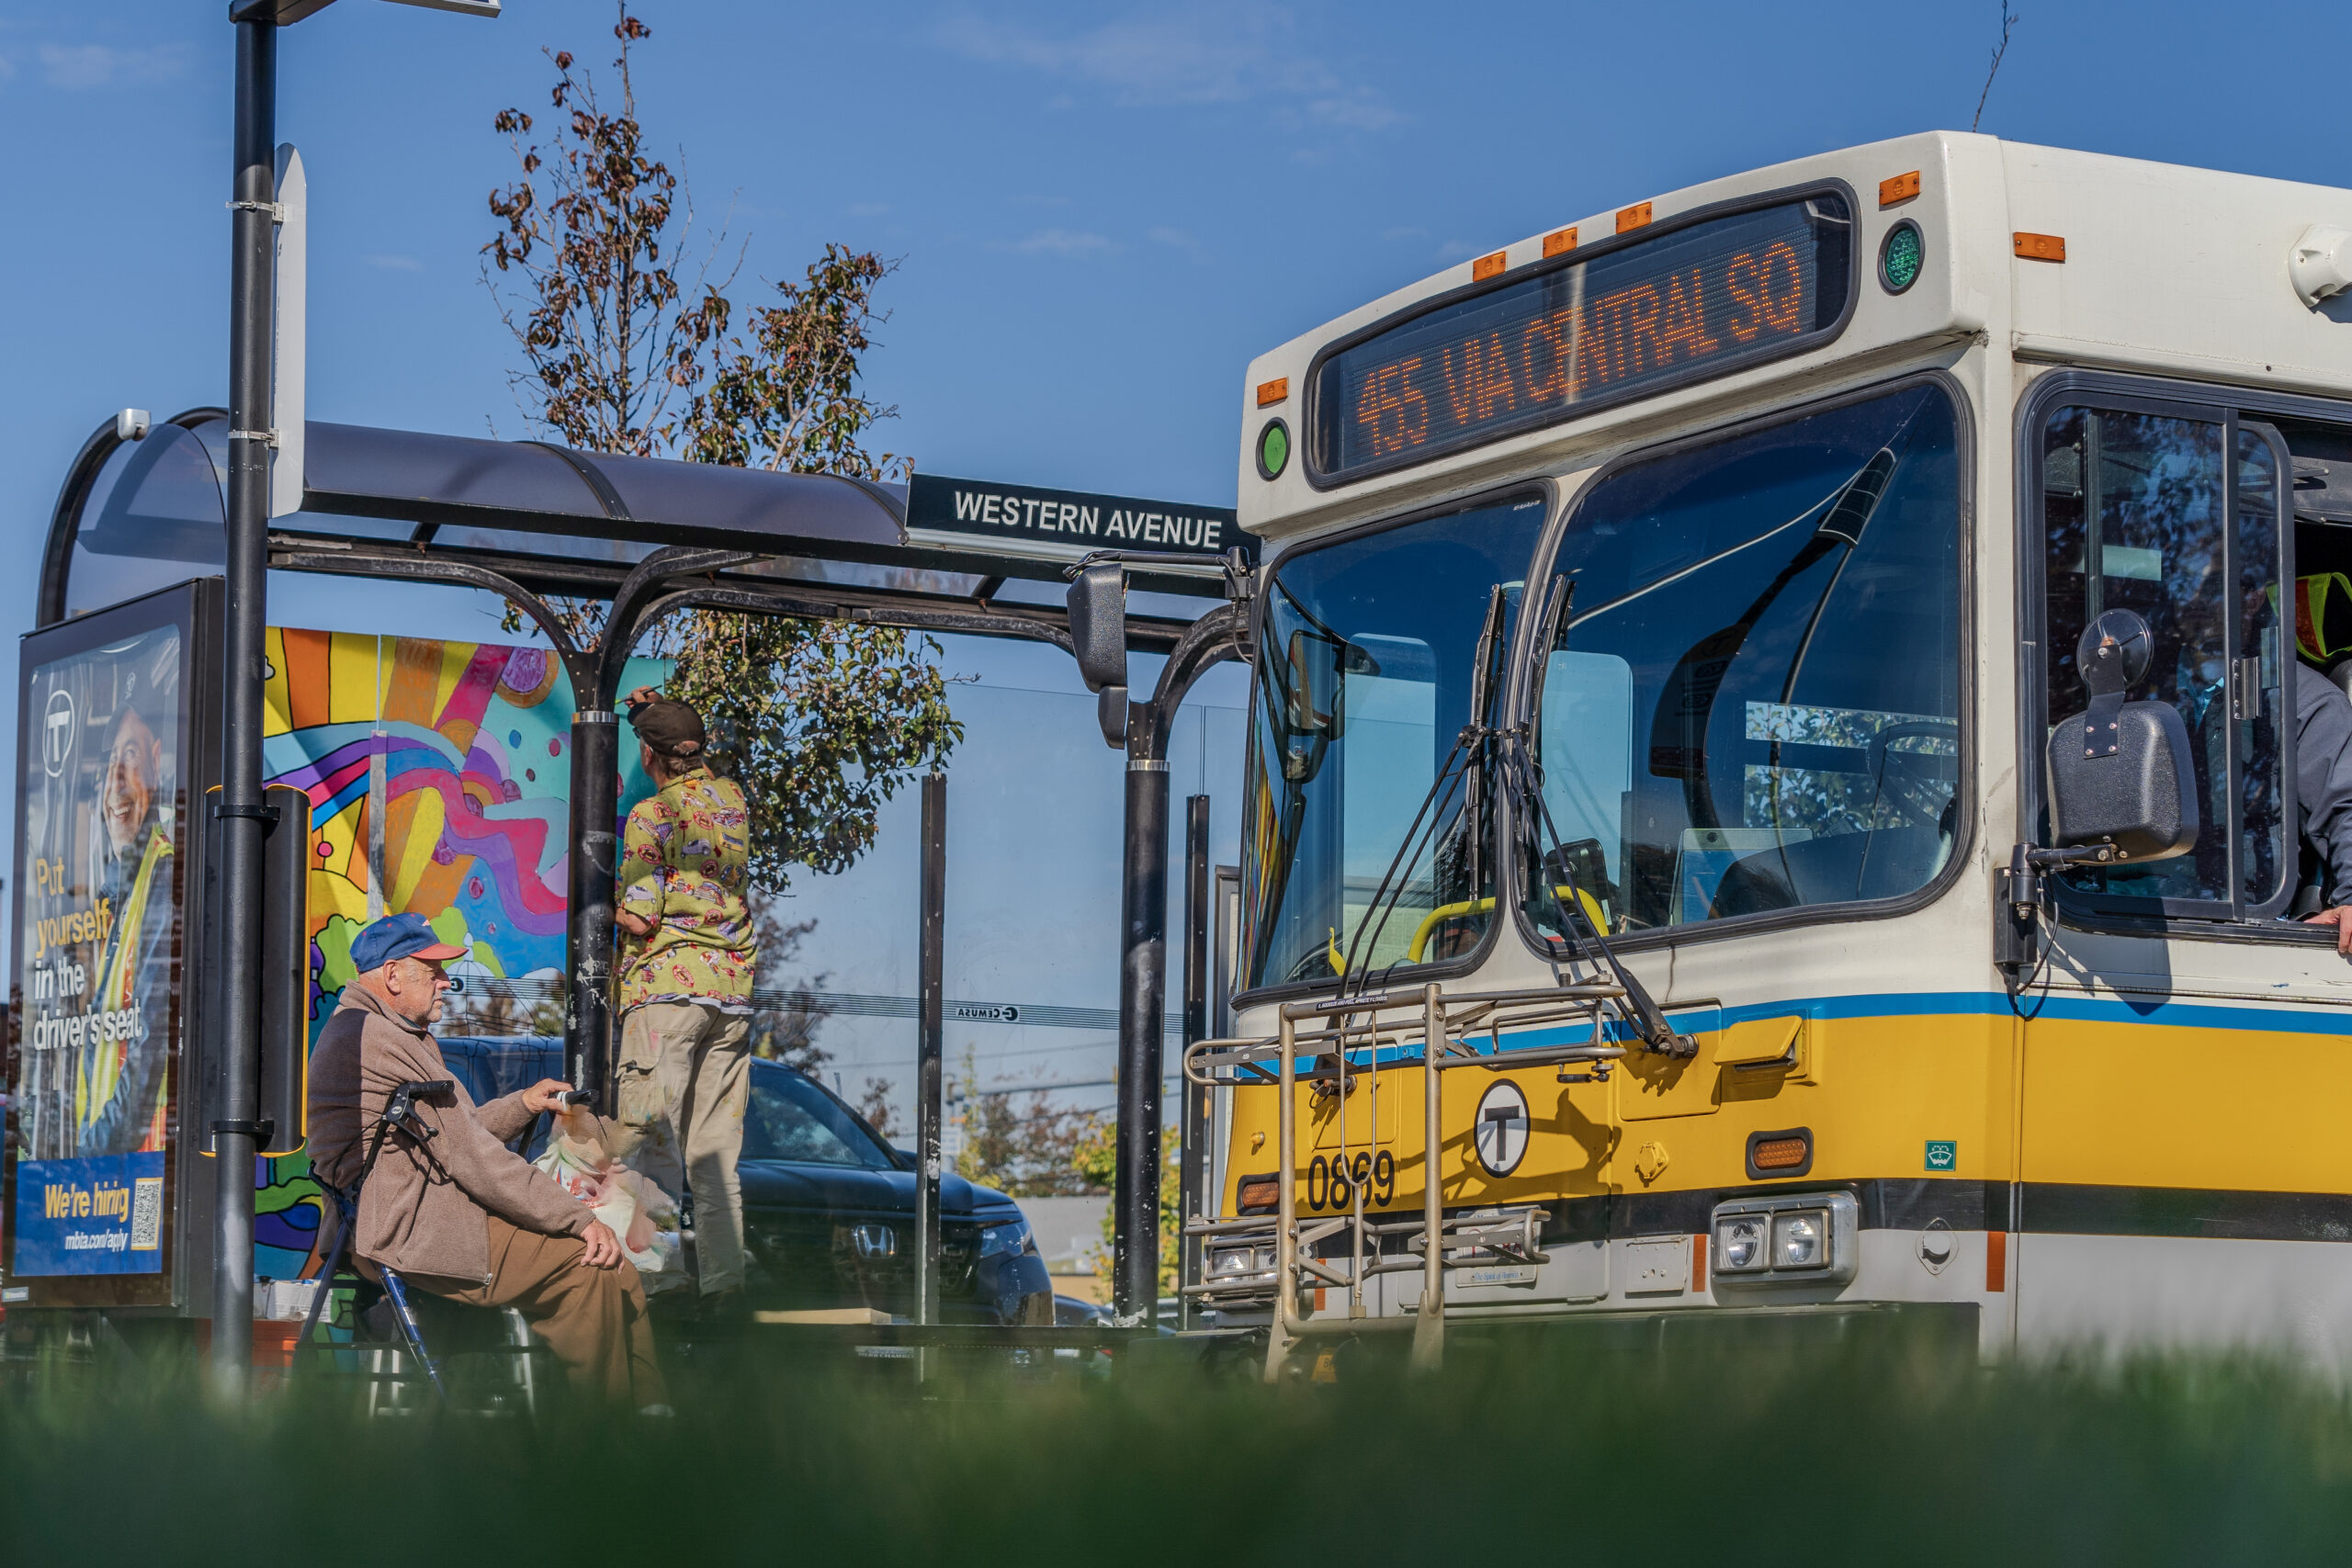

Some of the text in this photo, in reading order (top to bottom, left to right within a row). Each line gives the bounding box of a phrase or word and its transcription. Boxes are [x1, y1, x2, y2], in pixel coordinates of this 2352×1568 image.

[1359, 243, 1801, 457] 455 VIA CENTRAL SQ
[956, 491, 1221, 548] WESTERN AVENUE
[36, 856, 65, 898] Put
[36, 897, 111, 959] yourself
[34, 956, 85, 1000] in the
[33, 998, 142, 1051] driver's seat.
[1485, 1105, 1521, 1162] T
[45, 1180, 130, 1224] We're hiring
[1308, 1150, 1395, 1211] 0869
[64, 1228, 129, 1252] mbta.com/apply
